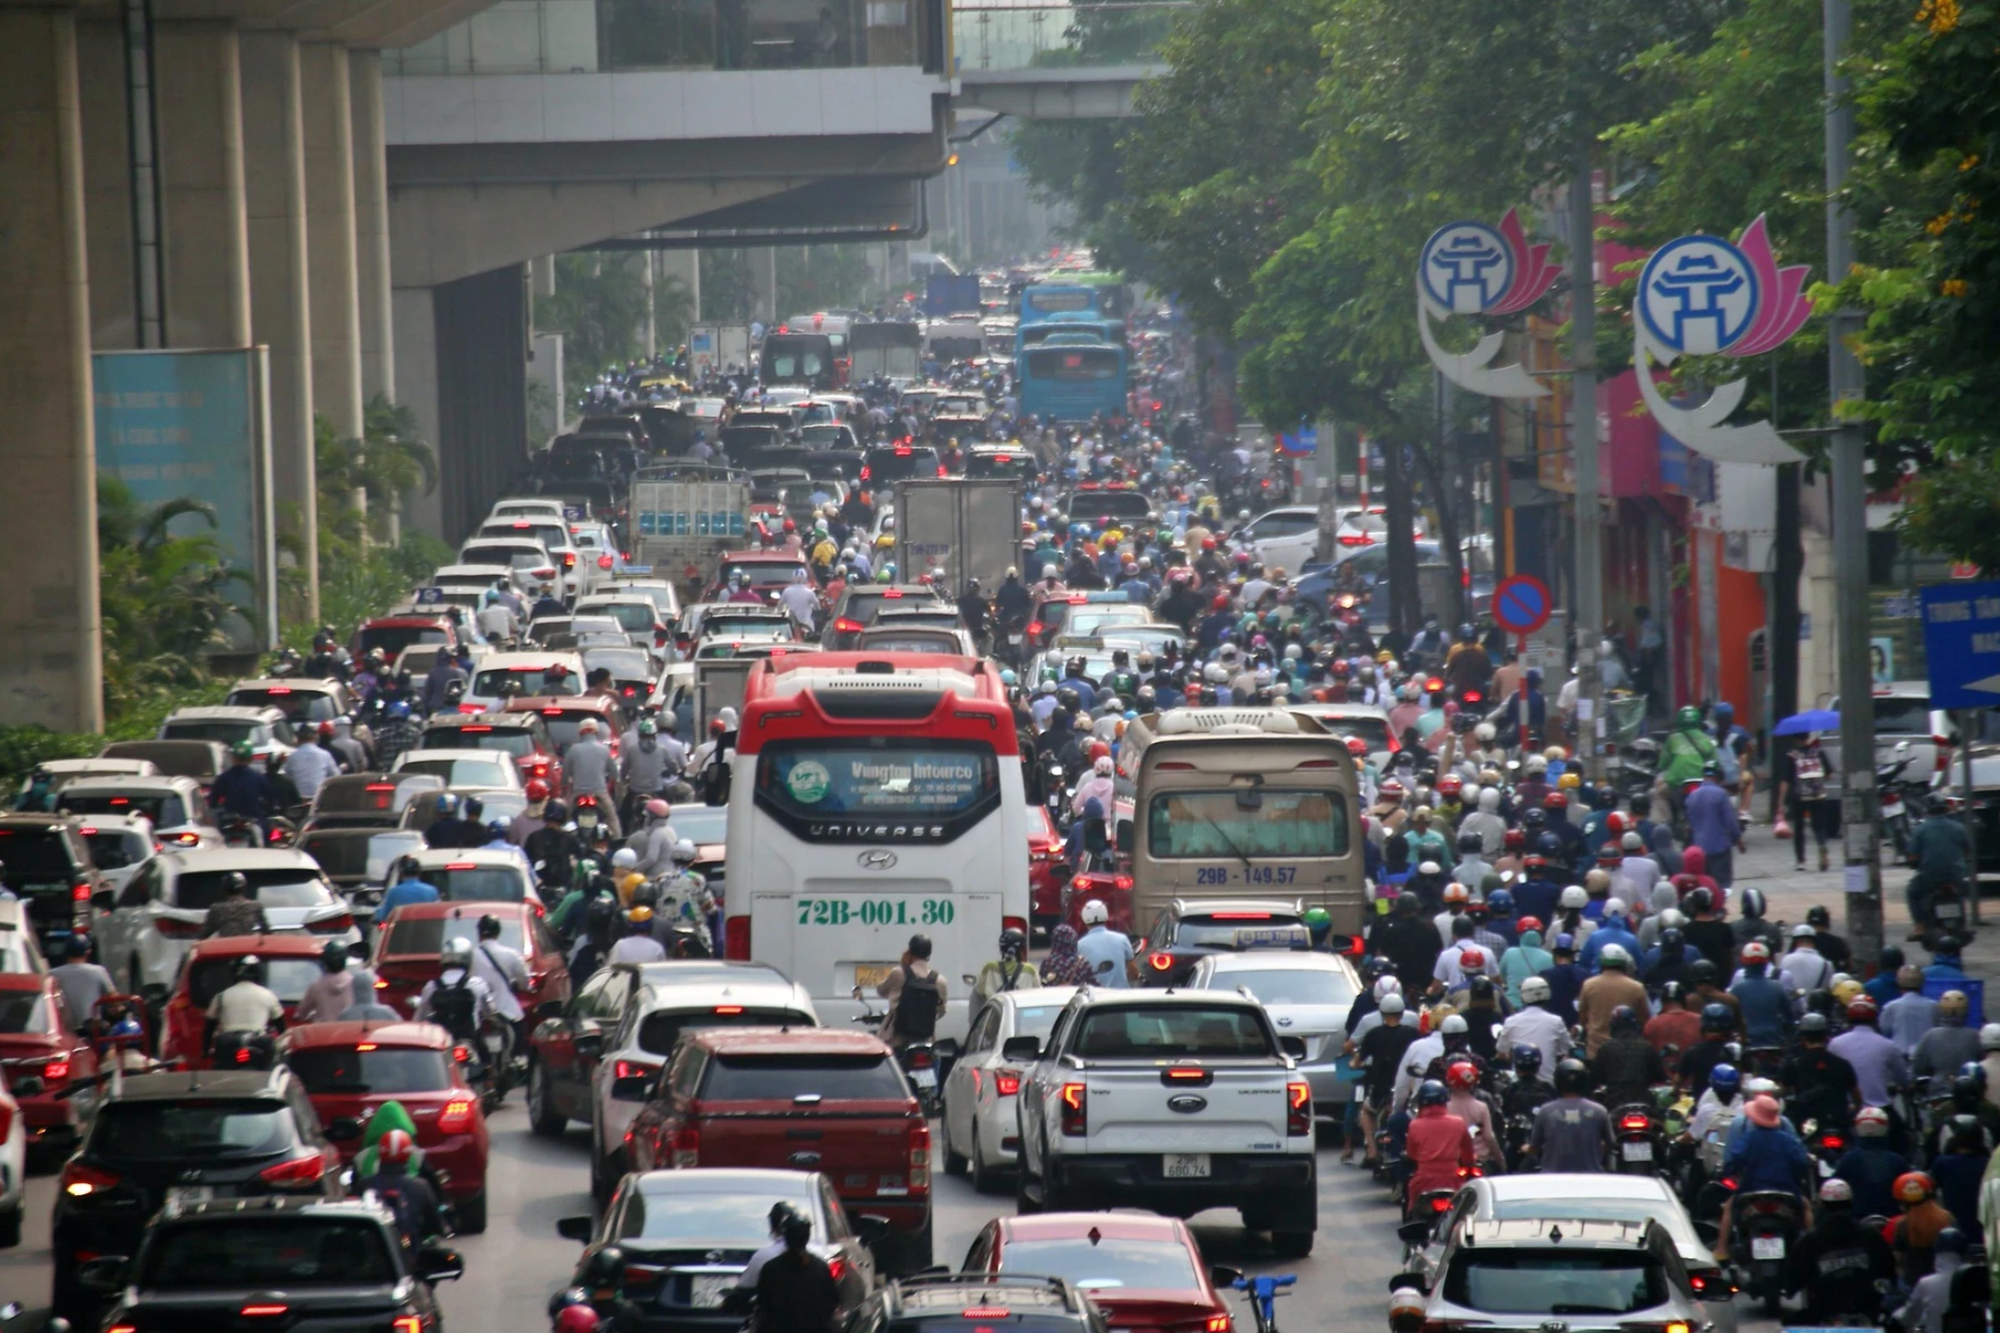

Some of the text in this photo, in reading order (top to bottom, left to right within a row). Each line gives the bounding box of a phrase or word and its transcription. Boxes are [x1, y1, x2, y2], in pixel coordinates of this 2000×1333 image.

[1197, 867, 1228, 885] 29B
[1244, 867, 1296, 885] 149.57
[798, 899, 955, 925] 72B-001.30
